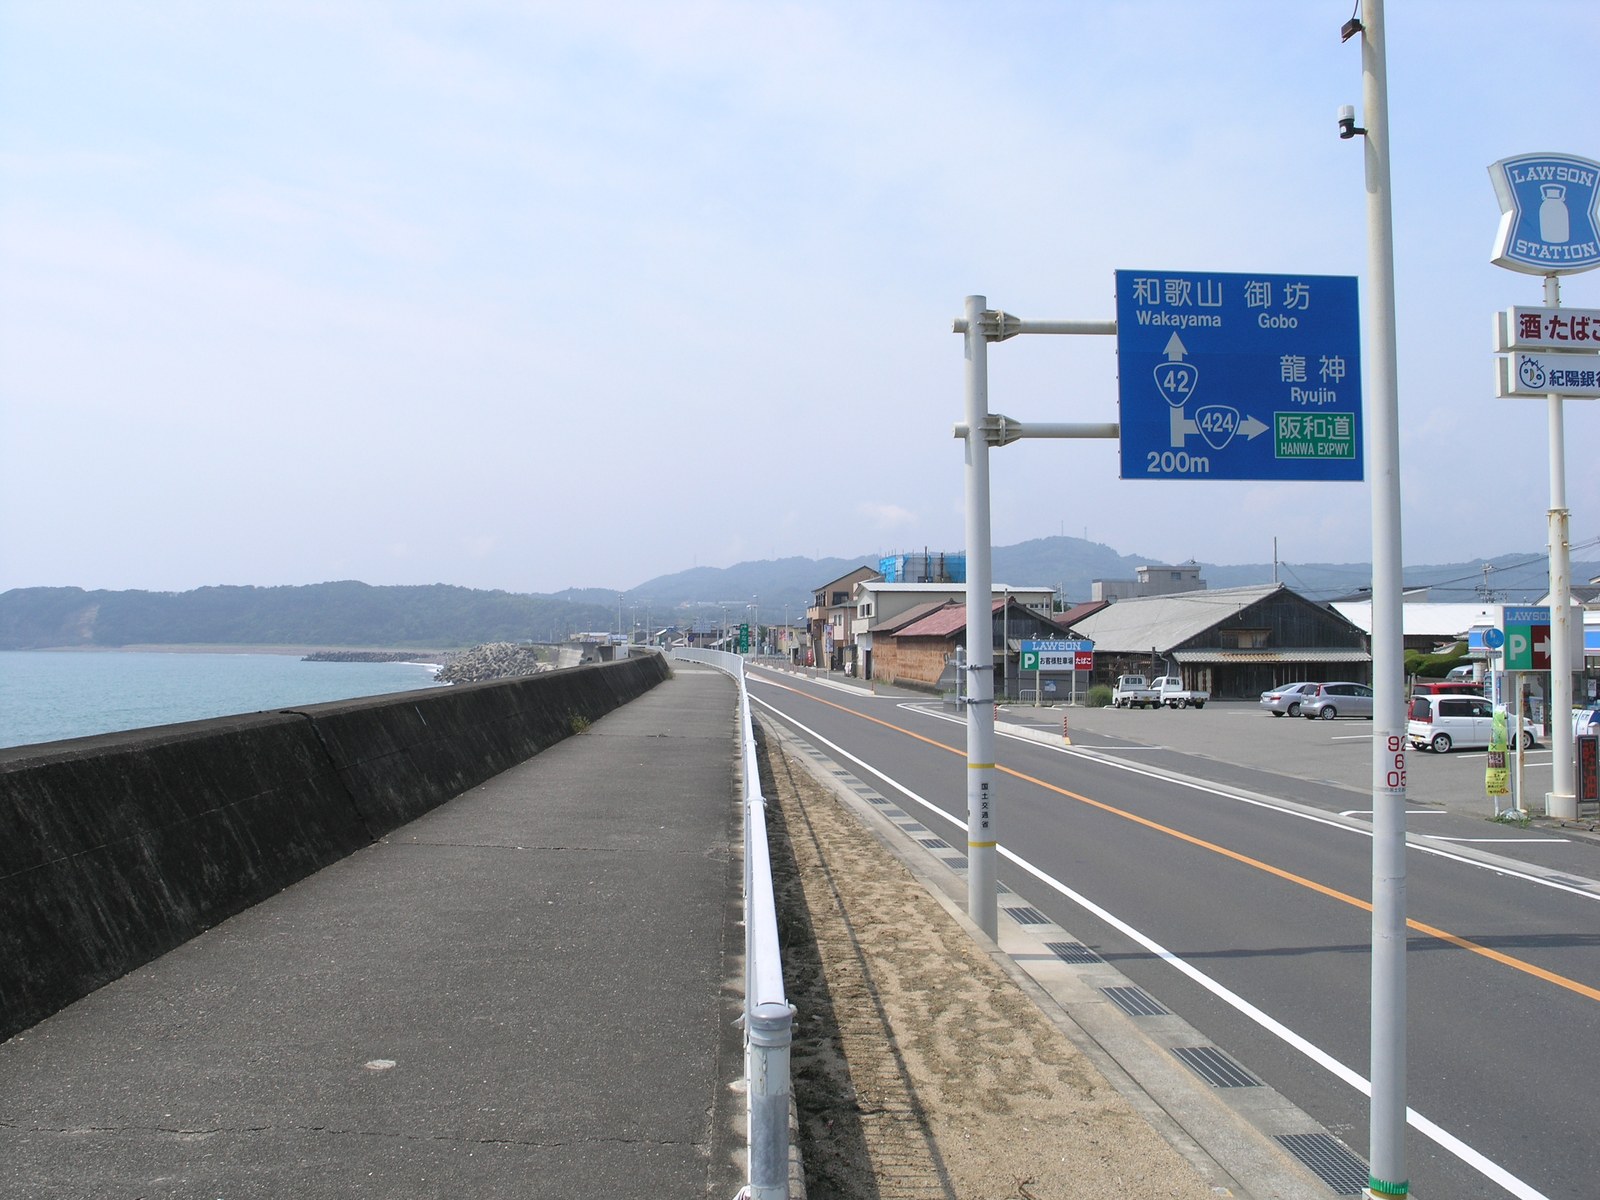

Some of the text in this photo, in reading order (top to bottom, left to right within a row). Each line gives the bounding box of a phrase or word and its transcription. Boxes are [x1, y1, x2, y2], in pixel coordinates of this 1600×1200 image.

[1512, 166, 1594, 187] LAWSON
[1515, 240, 1597, 260] STATION
[1132, 278, 1310, 310] 和歌山 御坊
[1136, 310, 1298, 329] Wakayama Gobo
[1279, 354, 1346, 384] 龍神
[1163, 370, 1189, 393] 42
[1290, 387, 1336, 405] Ryujin
[1201, 412, 1234, 433] 424
[1278, 415, 1350, 441] 阪和道
[1280, 442, 1349, 456] HANWA EXPWY
[1147, 451, 1210, 473] 200m
[1506, 611, 1551, 621] LAWSO
[1032, 641, 1082, 651] LAWSON
[1509, 634, 1527, 660] P
[1024, 653, 1036, 668] P
[1075, 657, 1092, 665] たばこ
[1394, 753, 1405, 770] 6
